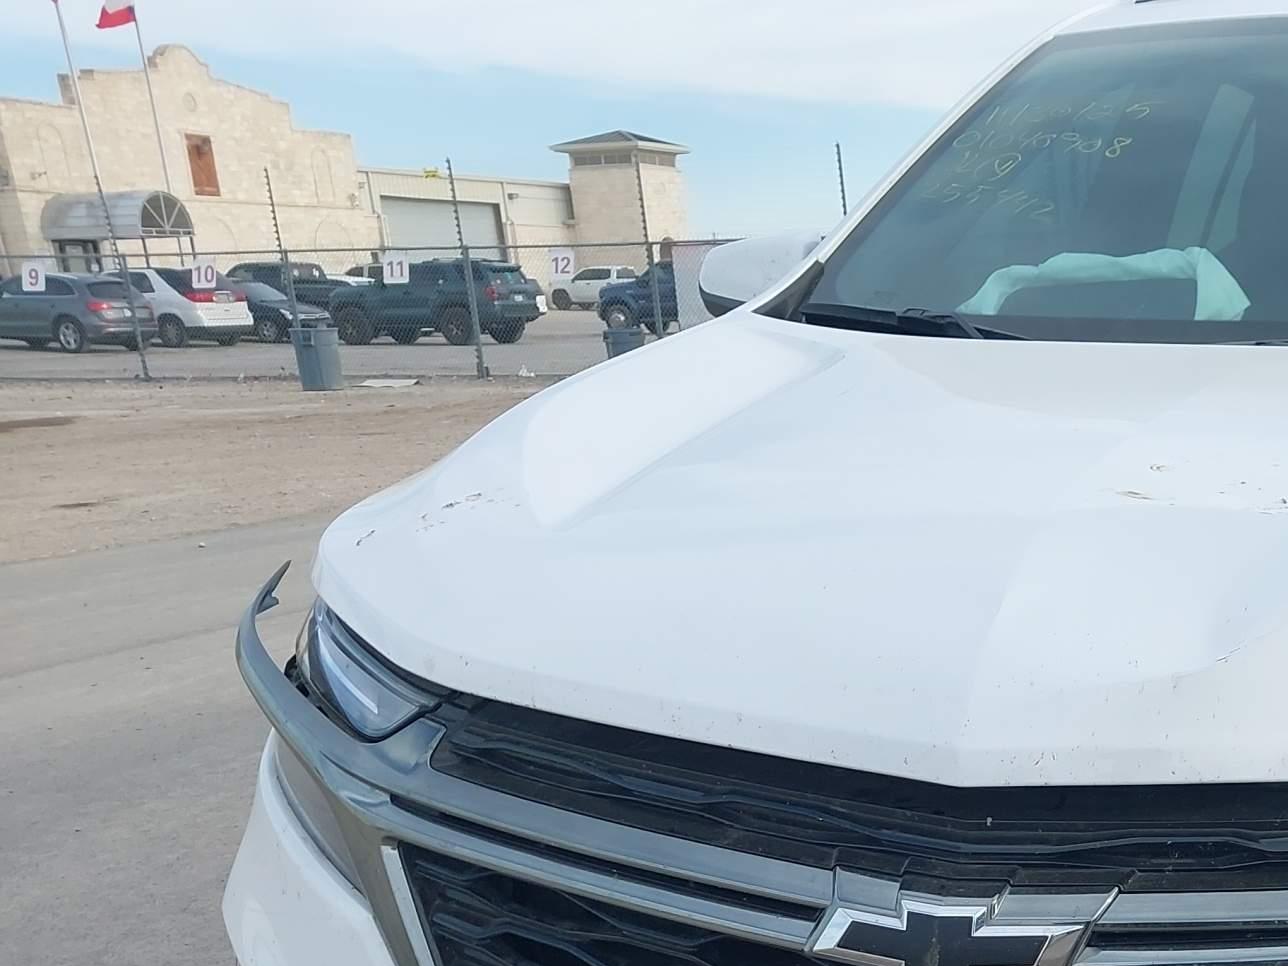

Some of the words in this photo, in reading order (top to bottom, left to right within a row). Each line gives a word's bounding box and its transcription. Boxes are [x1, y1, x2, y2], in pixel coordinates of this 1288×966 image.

[194, 264, 215, 284] 10
[386, 259, 404, 278] 11
[551, 256, 572, 275] 12
[28, 267, 40, 287] 9
